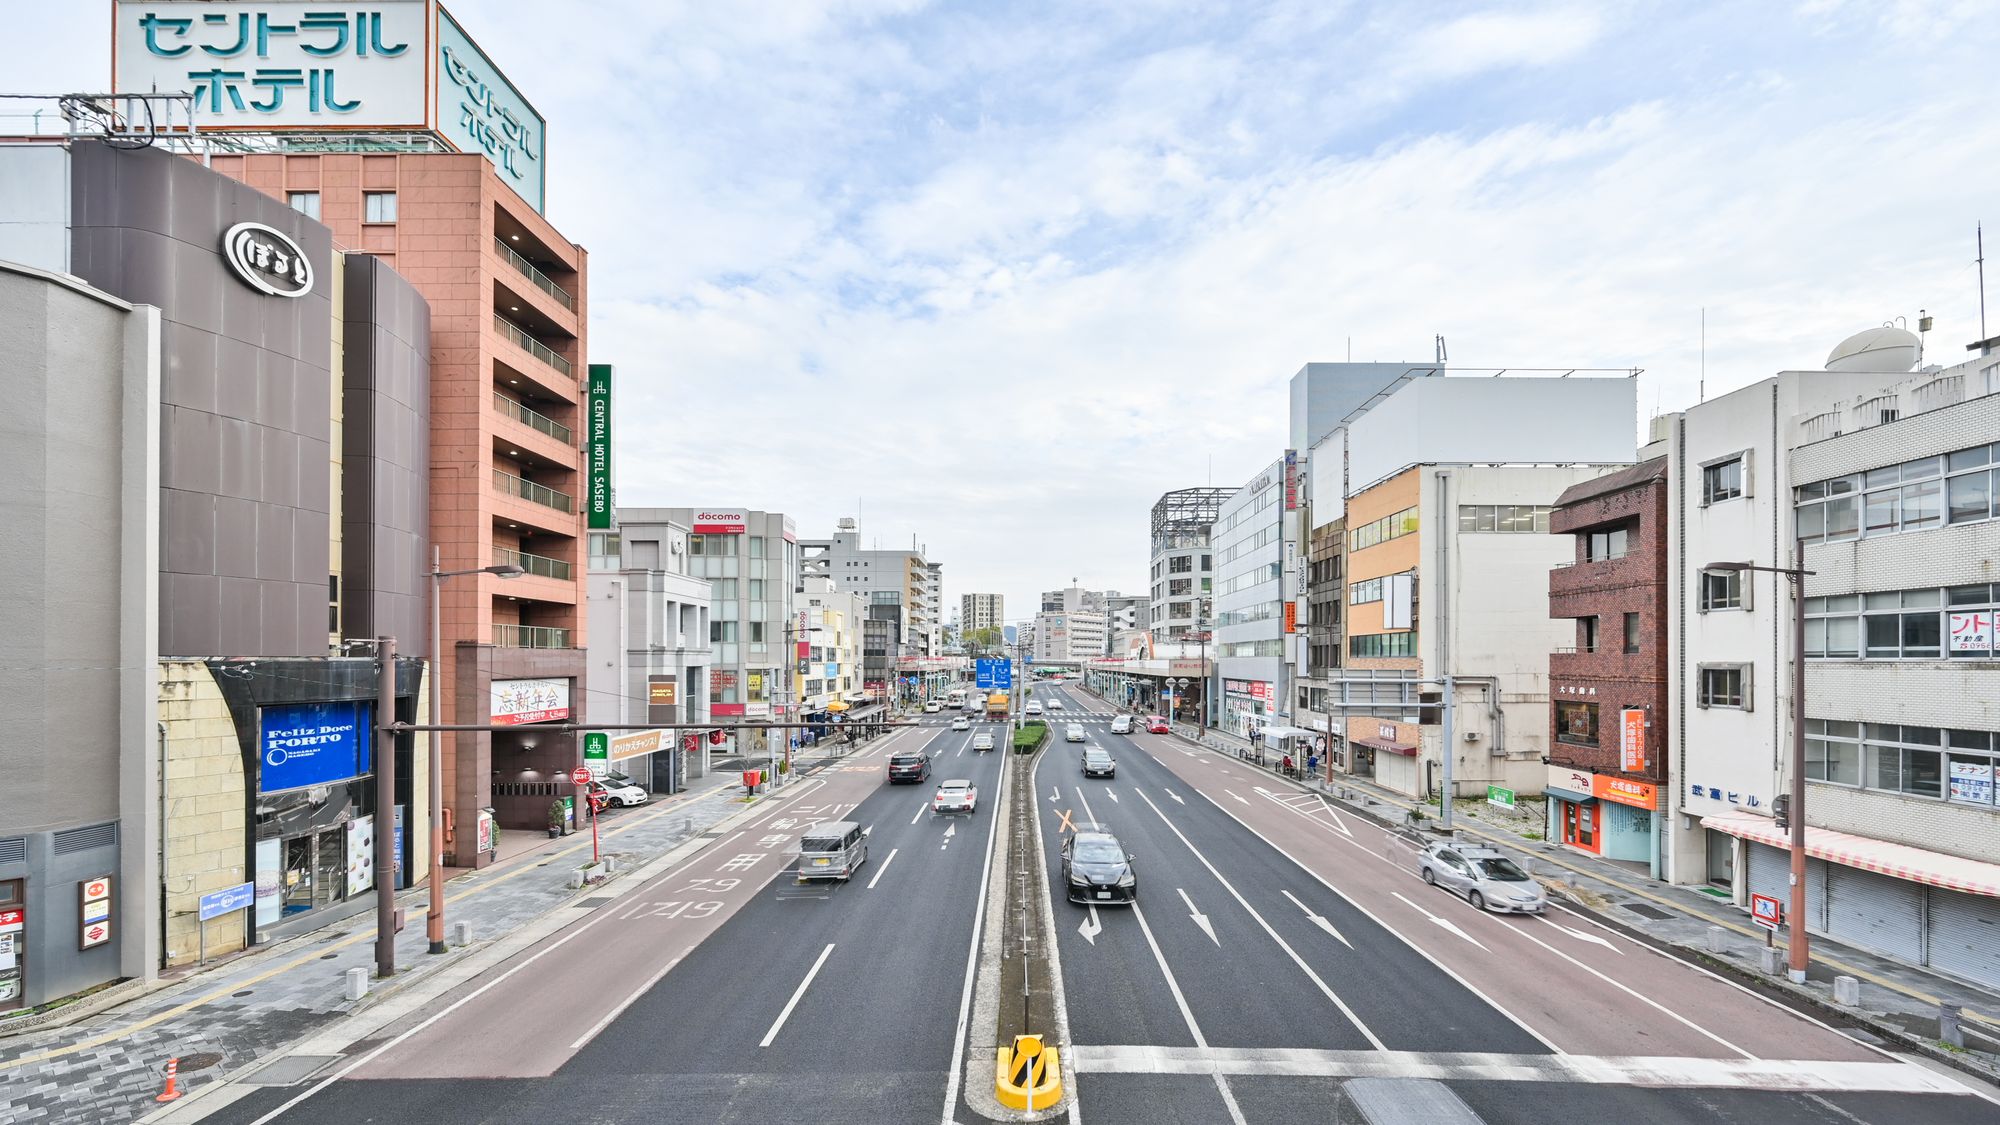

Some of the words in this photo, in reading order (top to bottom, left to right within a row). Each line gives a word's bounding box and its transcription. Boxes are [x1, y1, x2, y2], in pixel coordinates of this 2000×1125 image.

[138, 12, 409, 59] セントラル
[187, 68, 362, 114] ホテル
[442, 46, 538, 161] セントラル
[460, 101, 524, 180] ホテル
[594, 399, 605, 441] CENTRAL
[594, 443, 605, 474] HOTEL
[594, 476, 605, 513] SASEBO
[697, 512, 741, 521] docomo
[799, 611, 807, 639] docomo
[1952, 614, 1991, 634] ント
[499, 686, 559, 713] 忘新年会
[267, 728, 316, 739] Feliz
[320, 724, 353, 734] Doce
[267, 733, 342, 749] PORTO
[1691, 784, 1760, 807] 武富ビル
[675, 878, 743, 893] 7-9
[620, 900, 725, 920] 17-19
